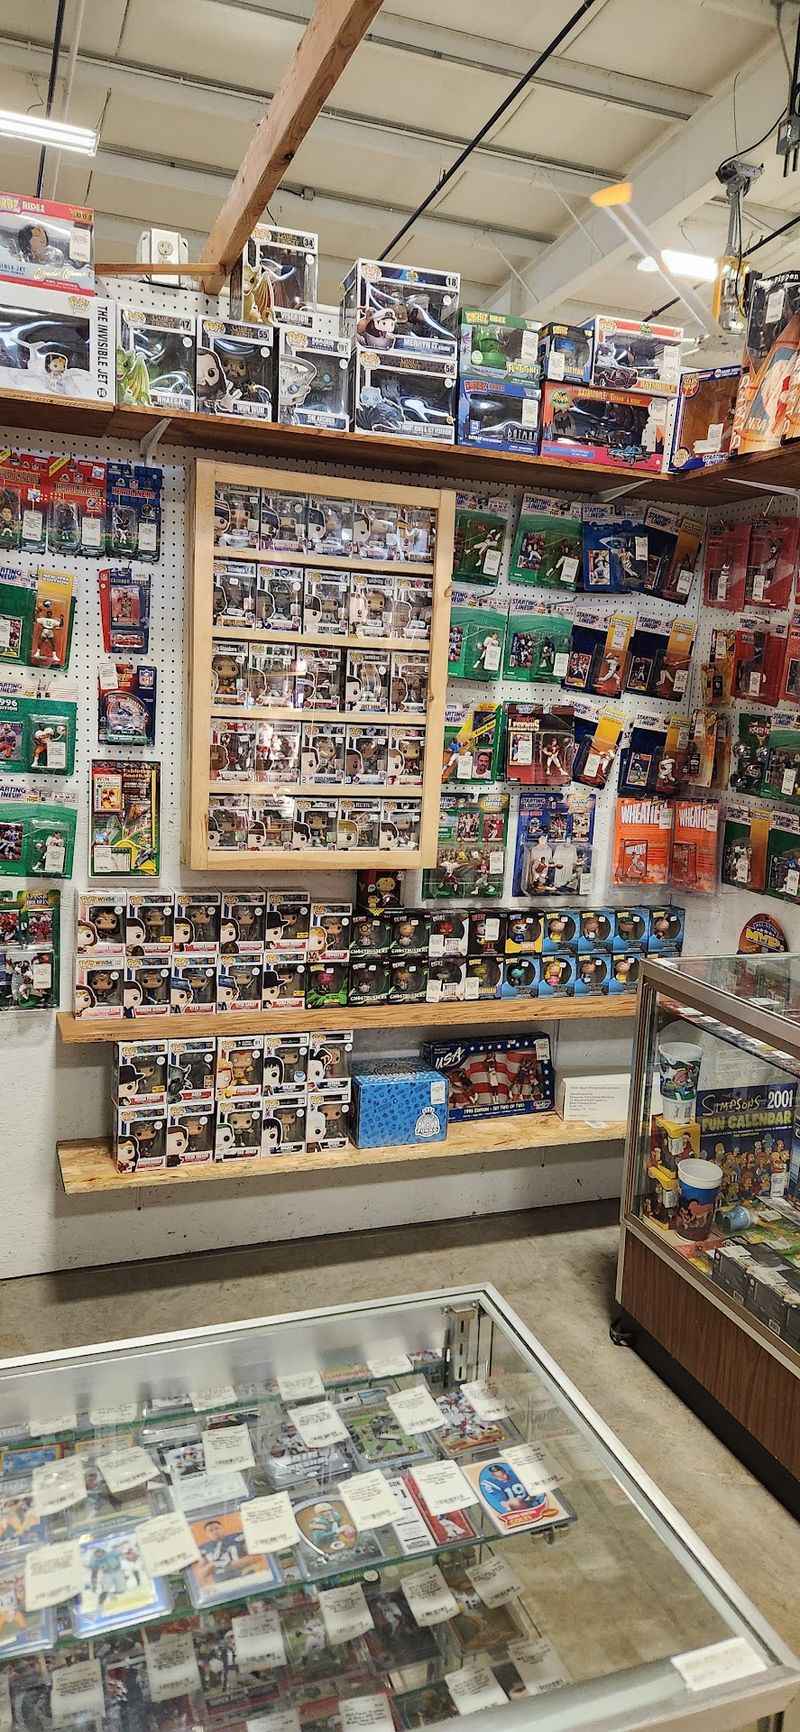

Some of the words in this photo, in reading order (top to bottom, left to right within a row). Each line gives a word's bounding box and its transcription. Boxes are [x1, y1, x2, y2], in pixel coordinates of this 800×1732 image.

[97, 306, 108, 322] THE
[97, 323, 108, 367] INVISIBLE
[97, 368, 108, 385] JET
[435, 1047, 466, 1070] USA
[768, 1089, 793, 1109] 2001
[702, 1114, 725, 1131] FUN
[728, 1109, 793, 1129] CALENDAR
[504, 1484, 525, 1499] 19
